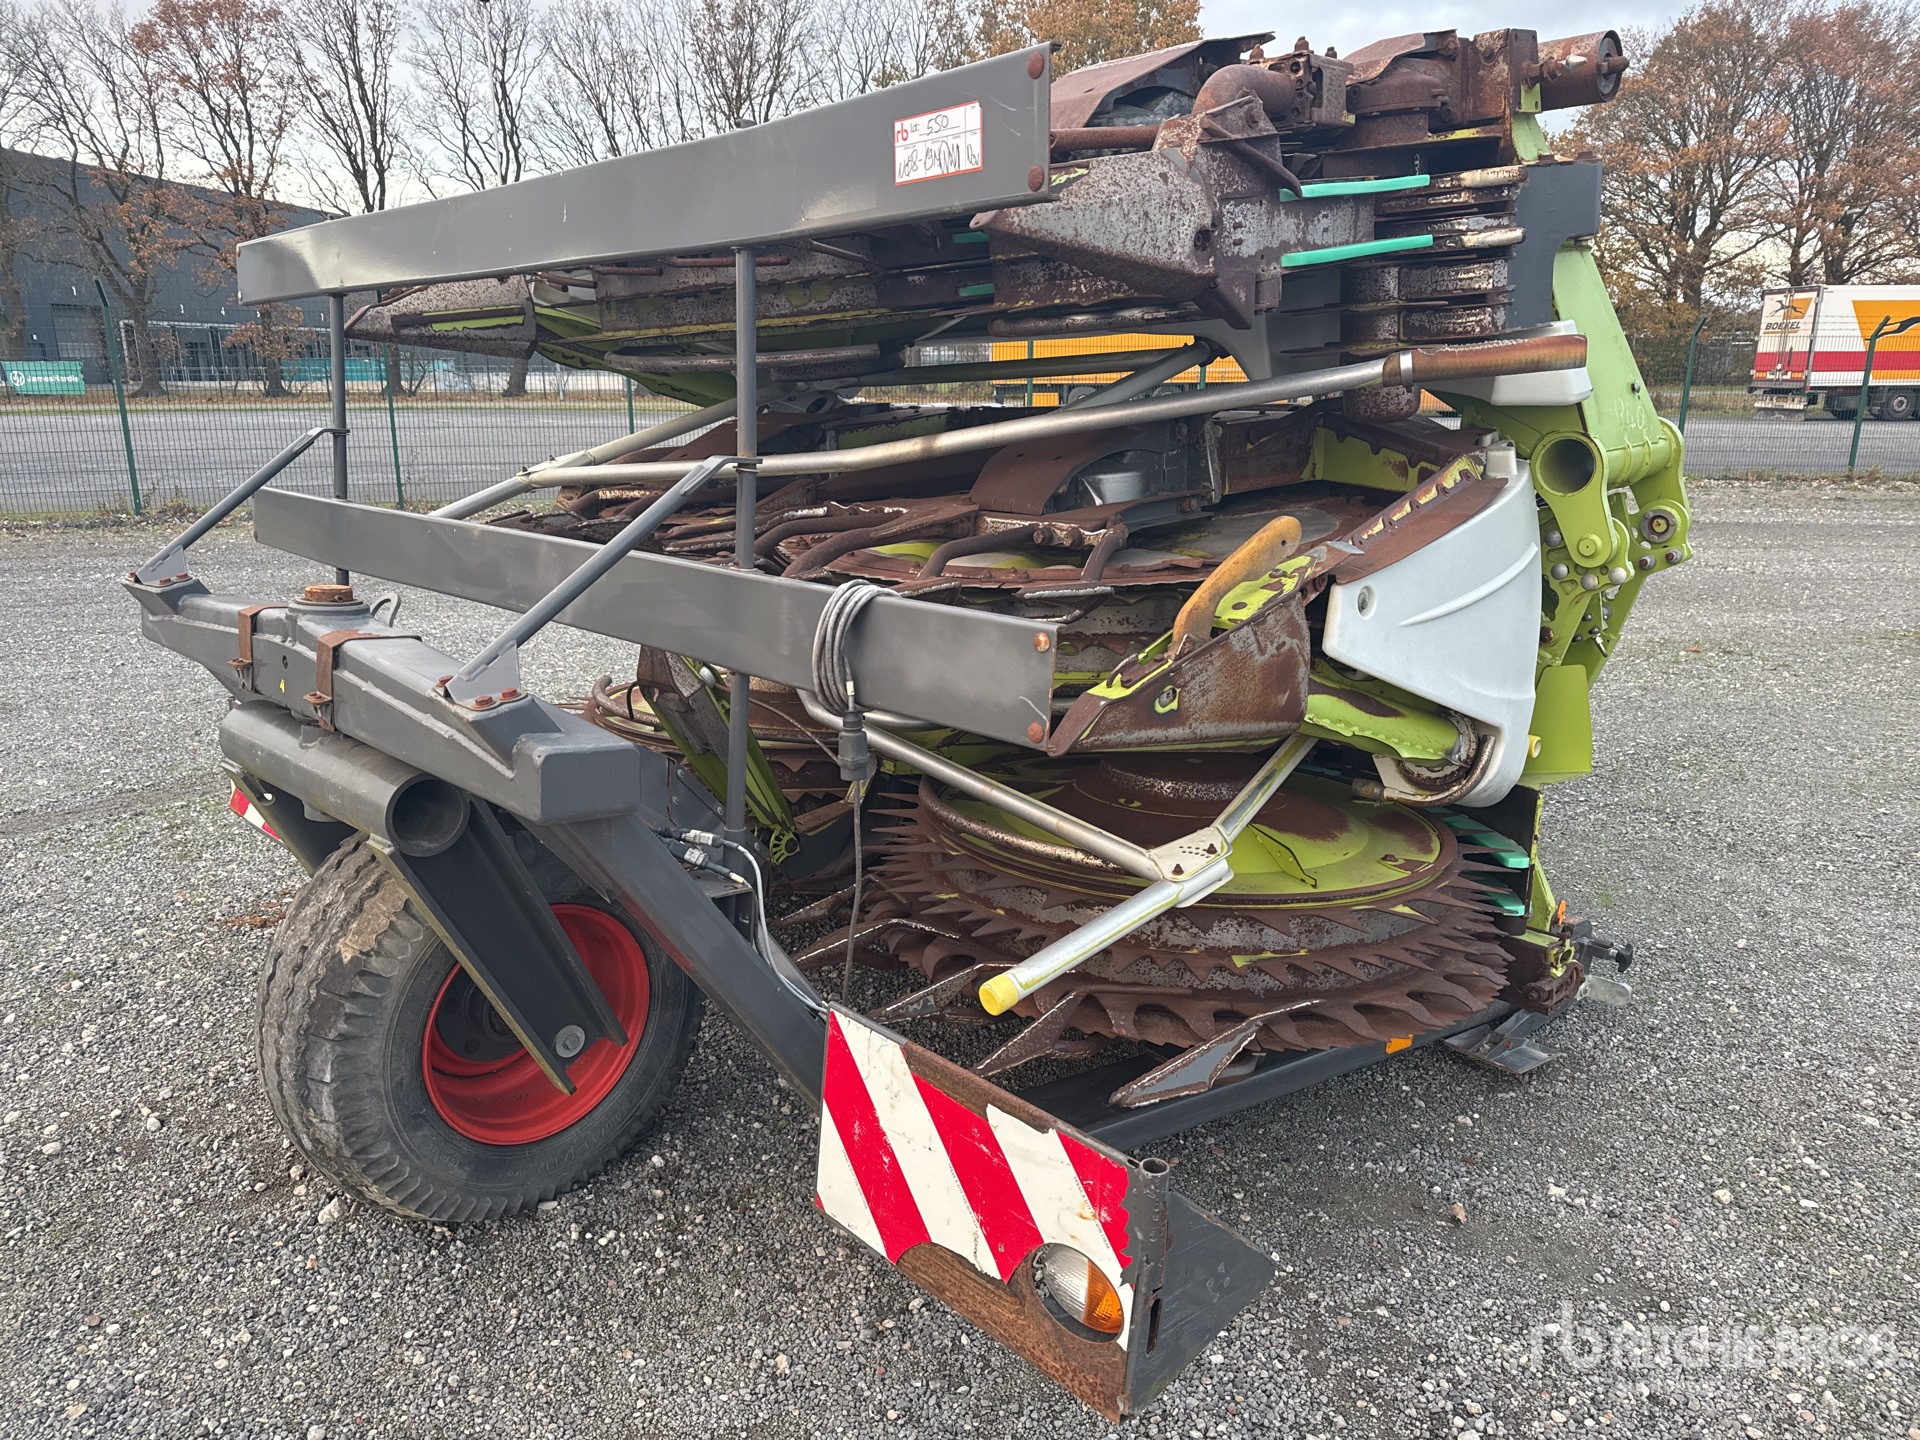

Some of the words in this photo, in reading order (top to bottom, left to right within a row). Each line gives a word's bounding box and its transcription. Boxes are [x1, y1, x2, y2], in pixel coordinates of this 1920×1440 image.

[897, 122, 909, 143] rb
[927, 113, 949, 136] 550
[1765, 321, 1800, 330] BOEKEL
